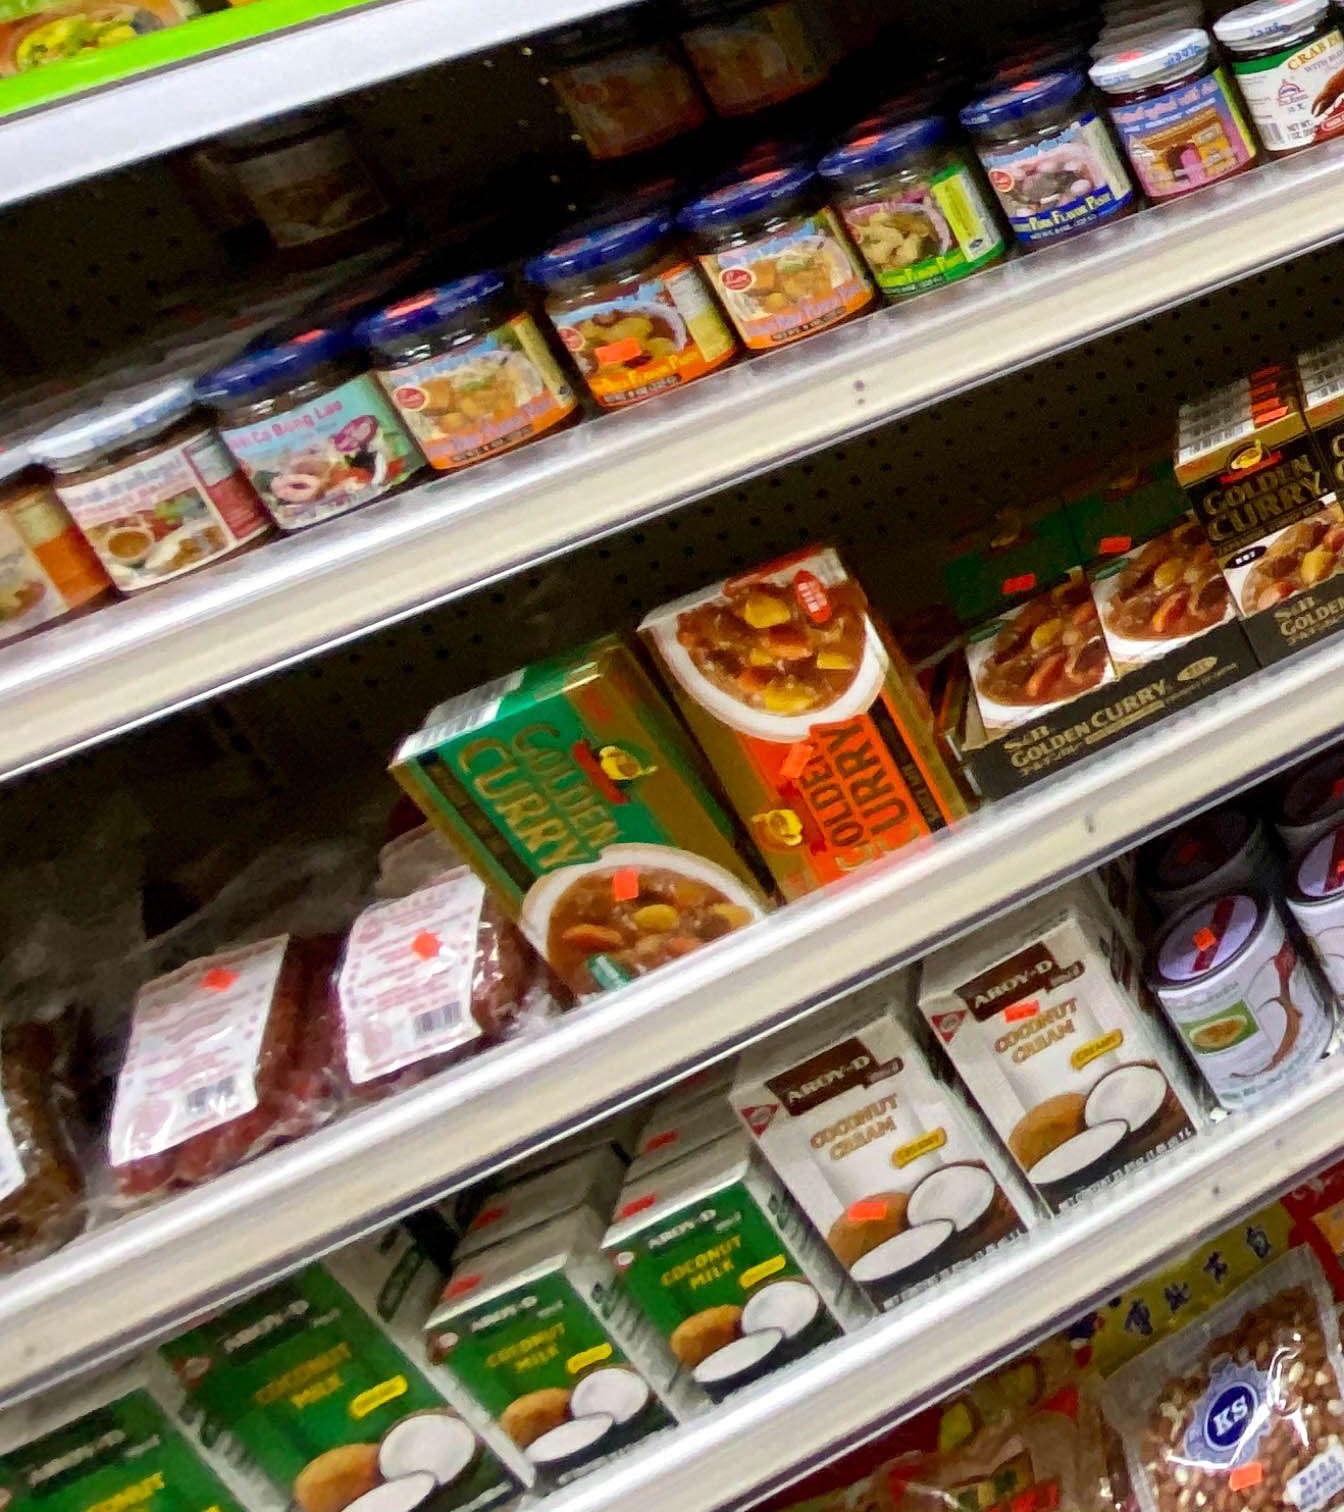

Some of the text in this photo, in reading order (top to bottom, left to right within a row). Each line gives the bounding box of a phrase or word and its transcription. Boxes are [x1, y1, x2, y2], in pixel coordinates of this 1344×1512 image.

[1287, 43, 1320, 73] CRAB
[1202, 453, 1316, 517] GOLDEN
[1206, 470, 1326, 542] CURRY
[1010, 677, 1169, 769] GOLDEN CURRY
[457, 737, 591, 870] CURRY
[511, 722, 625, 849] GOLDEN
[972, 959, 1055, 1010] AROY-D
[993, 997, 1080, 1055] COCONUT
[1011, 1018, 1077, 1064] CREAM
[785, 1054, 872, 1105] AROY-D
[809, 1092, 899, 1150] COCONUT
[829, 1114, 898, 1161] CREAM
[659, 1233, 744, 1289] COCONUT
[686, 1258, 737, 1292] MILK
[1213, 1395, 1249, 1437] KS
